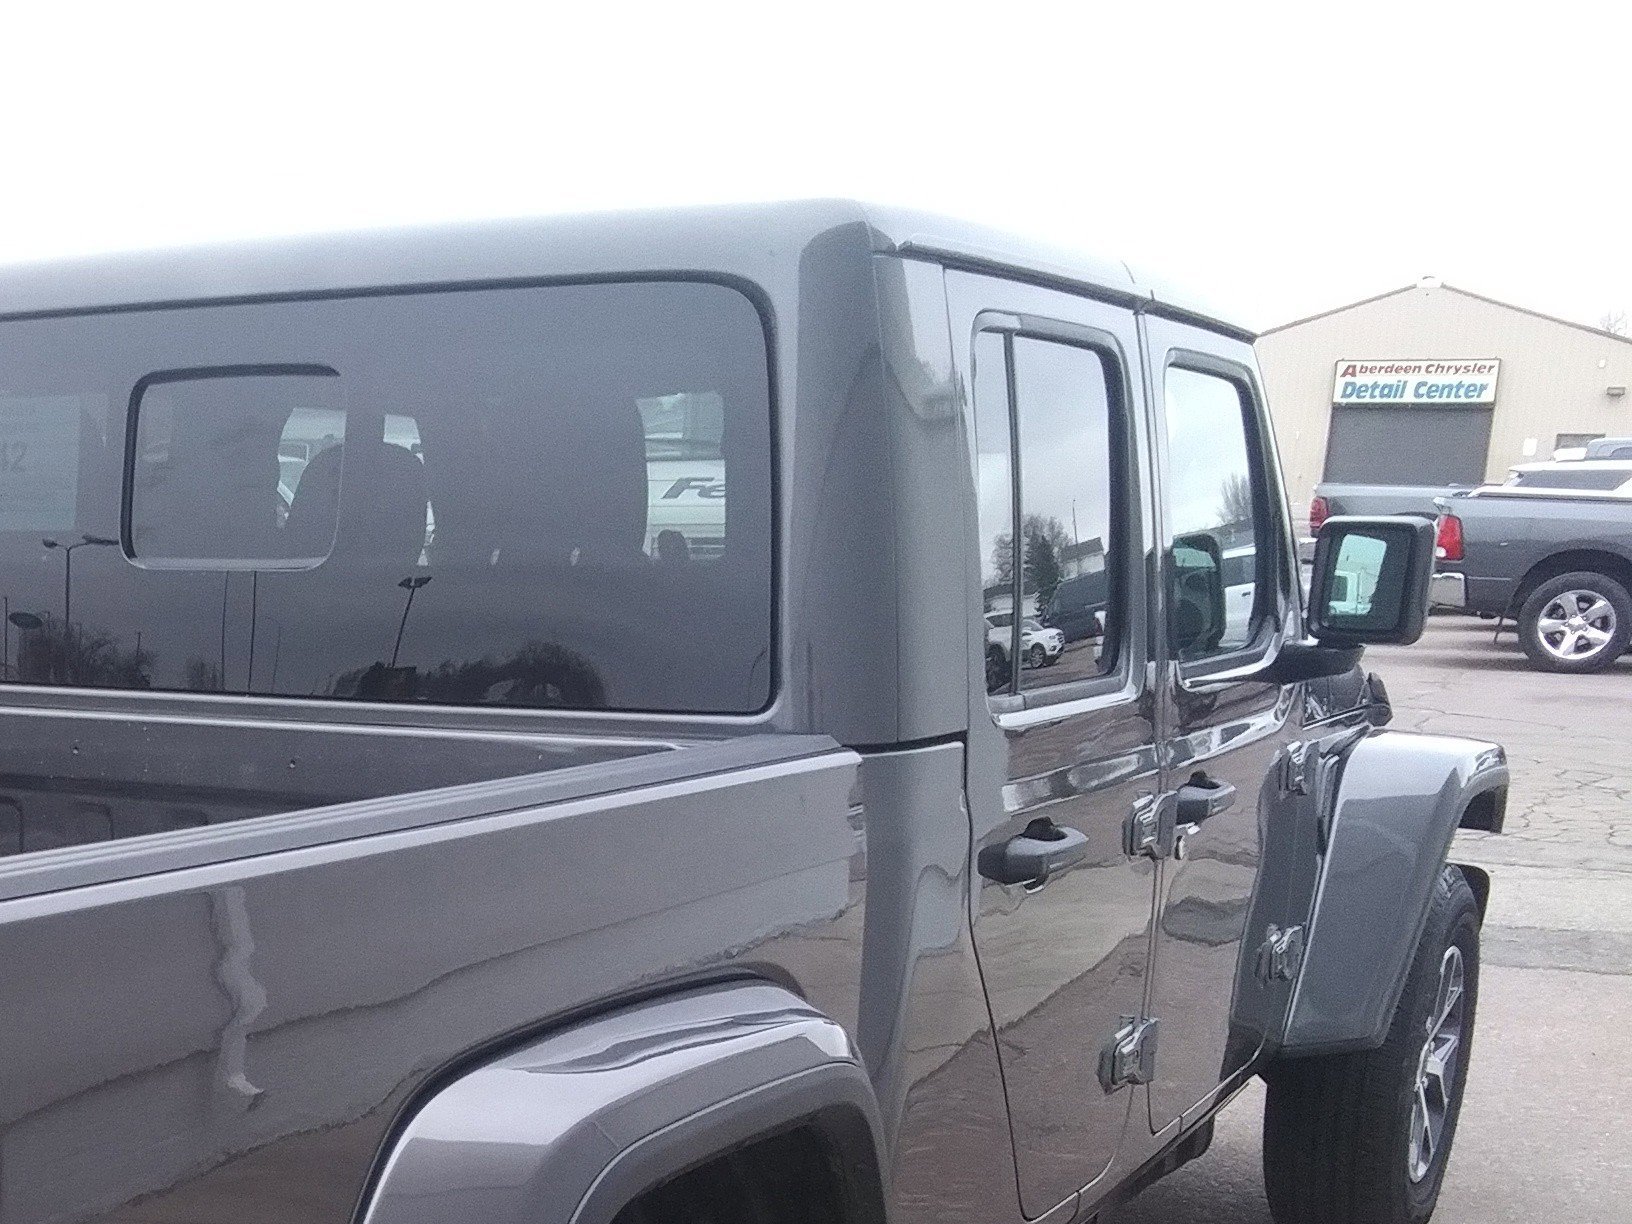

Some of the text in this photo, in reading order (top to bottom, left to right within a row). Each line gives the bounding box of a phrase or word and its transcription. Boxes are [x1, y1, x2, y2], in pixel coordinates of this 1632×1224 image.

[1340, 363, 1496, 378] Aberdeen Chrysler
[1340, 380, 1489, 399] Detail Center
